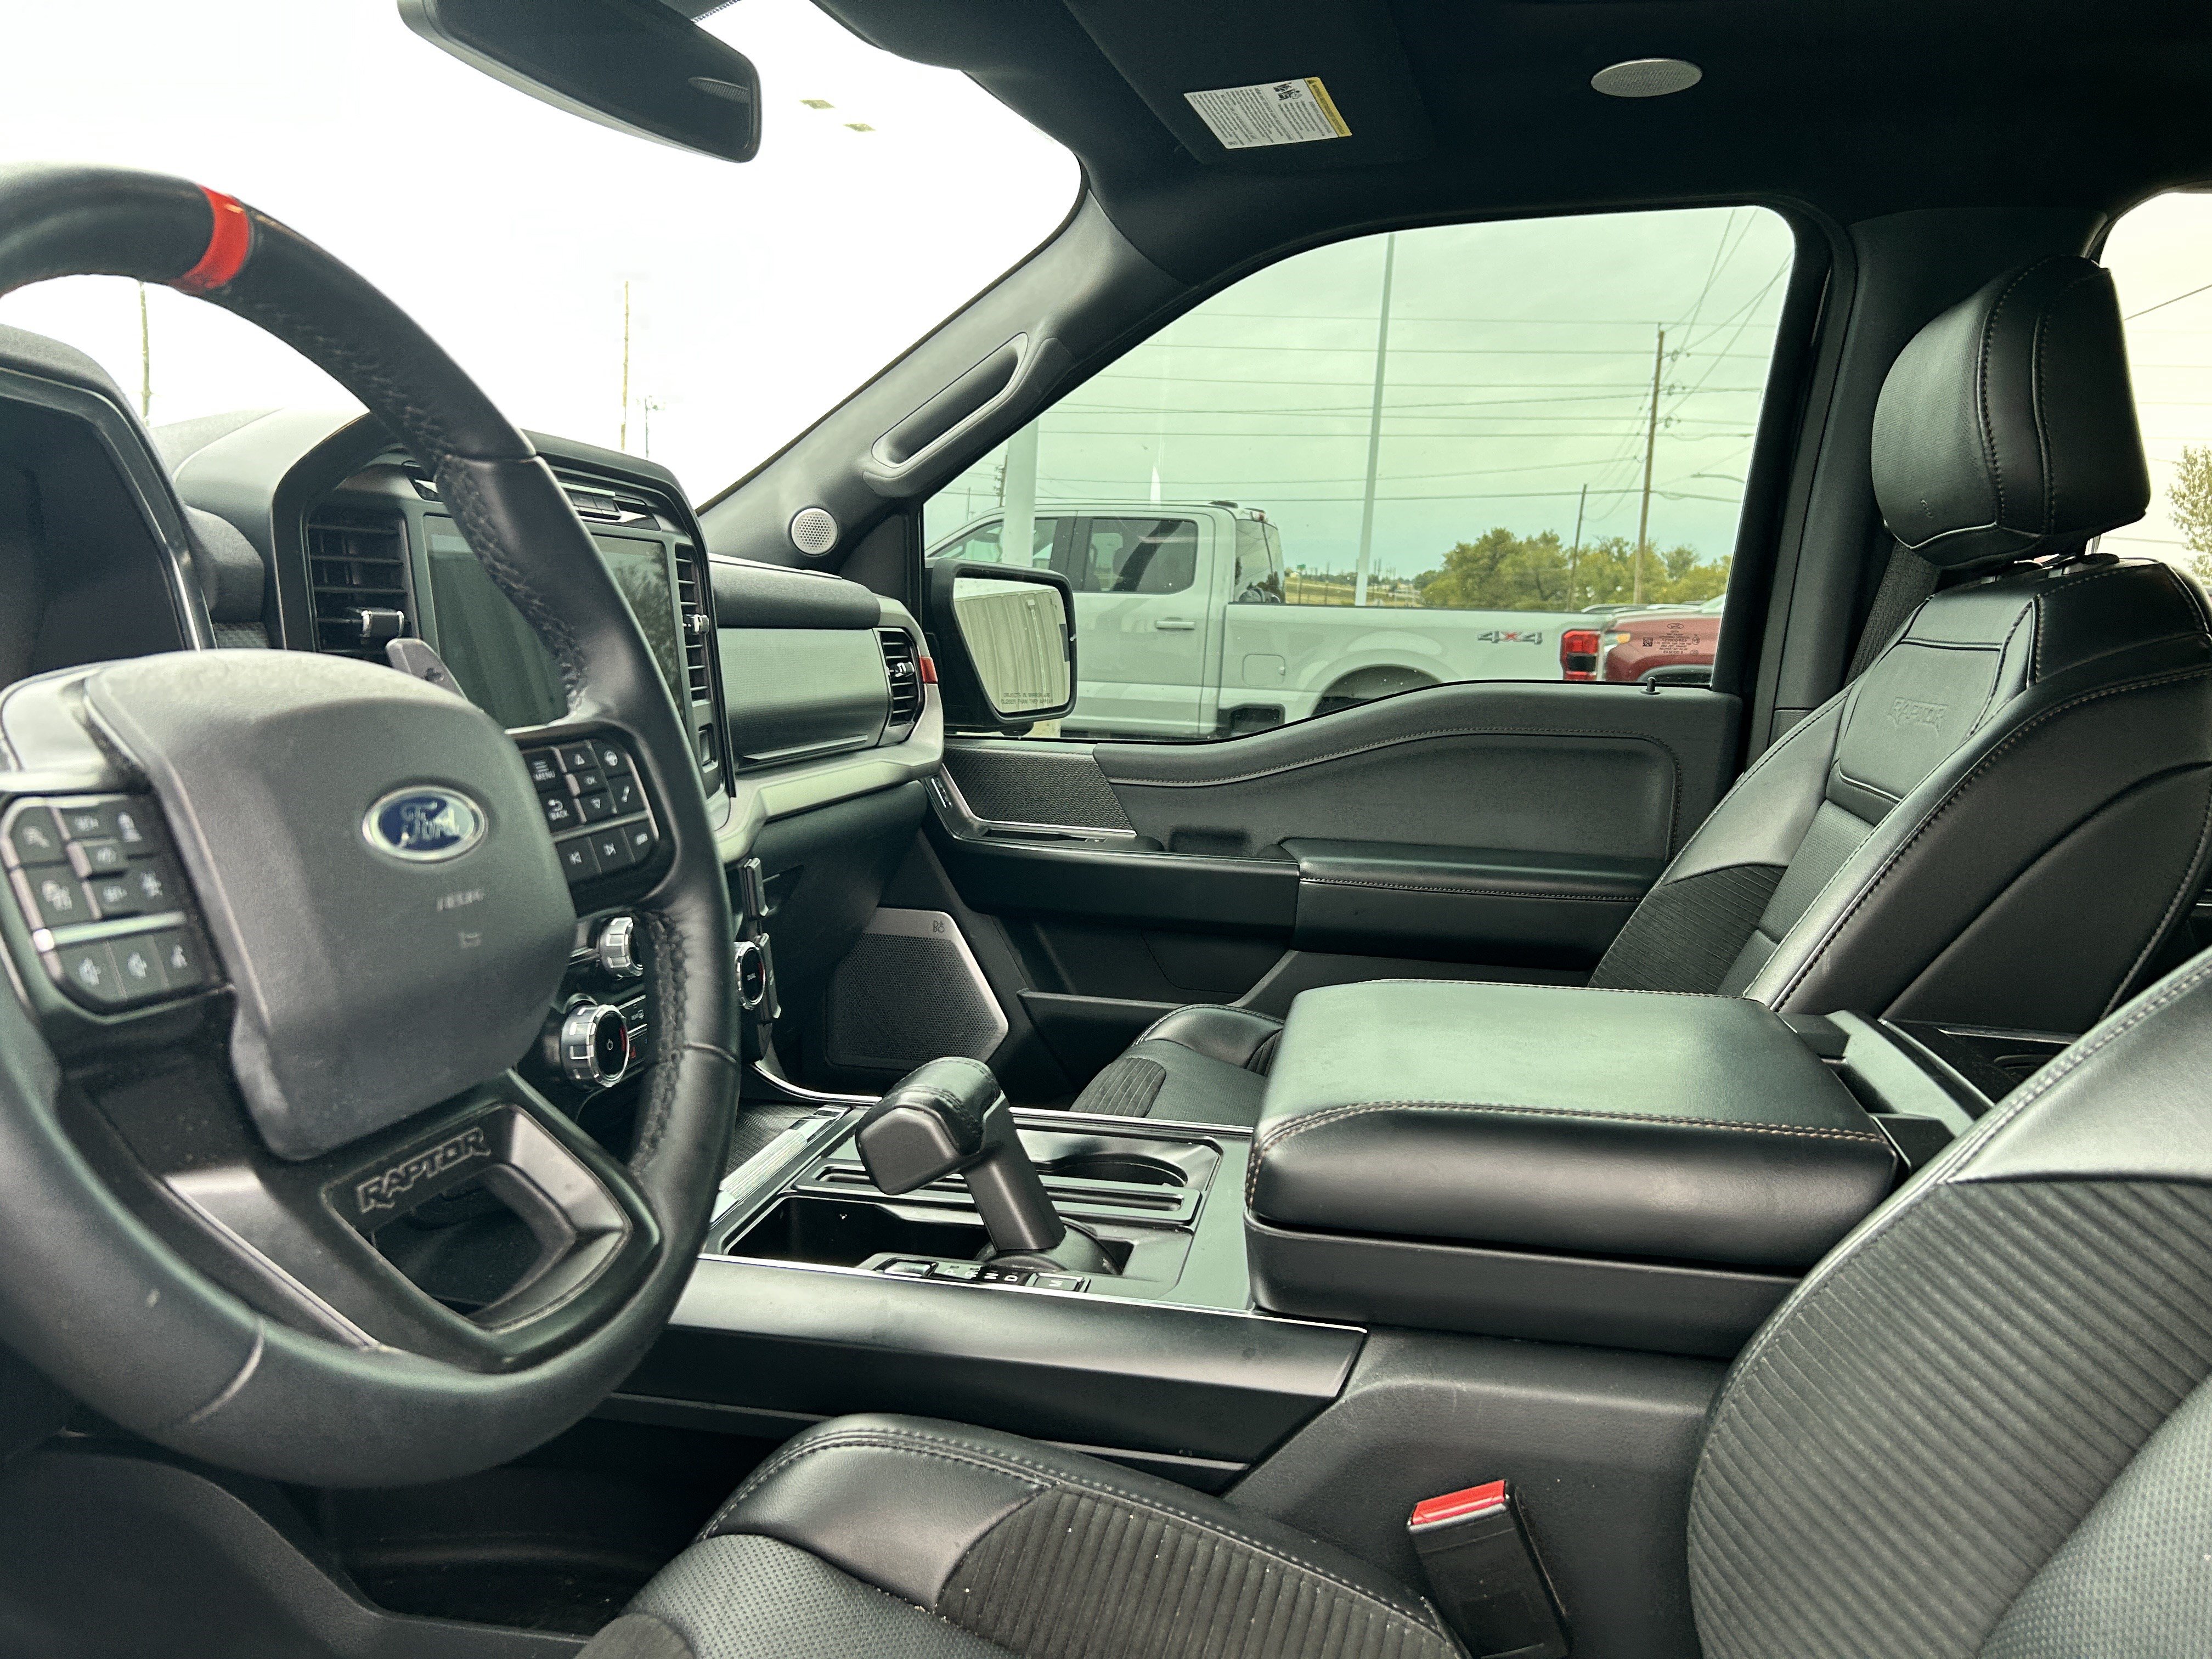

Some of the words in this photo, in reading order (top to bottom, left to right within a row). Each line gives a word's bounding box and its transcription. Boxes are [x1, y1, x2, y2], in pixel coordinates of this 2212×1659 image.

[534, 770, 556, 781] MENU
[585, 775, 596, 785] OK
[549, 809, 569, 821] BACK
[399, 801, 460, 847] Ford
[357, 1126, 492, 1214] RAPTOR
